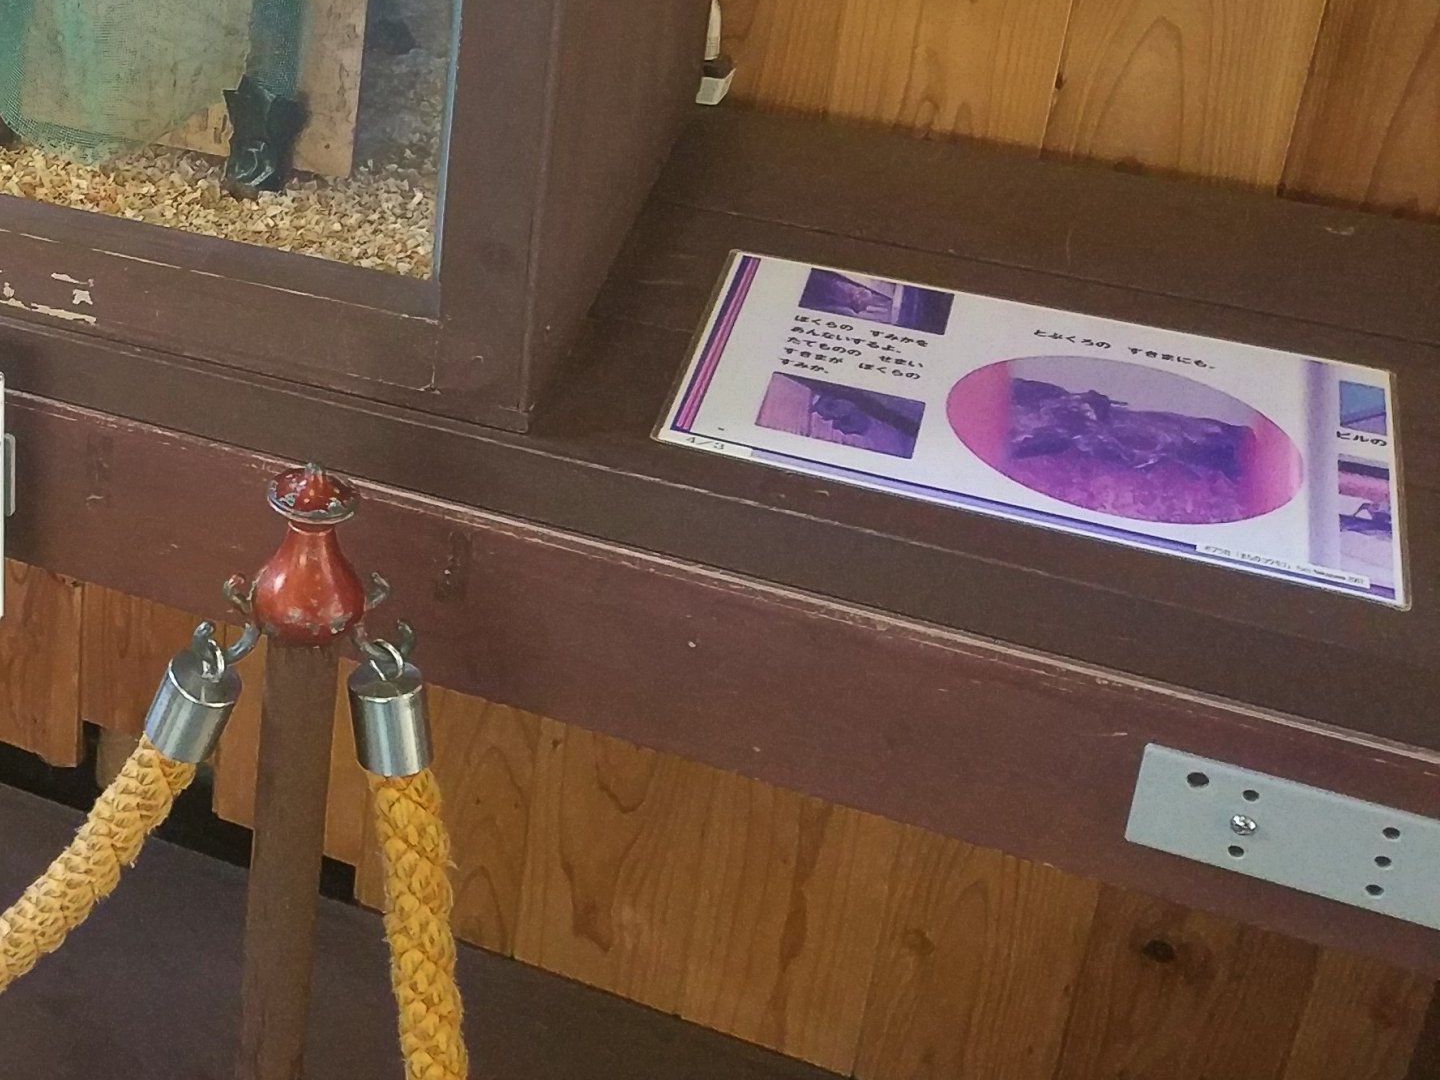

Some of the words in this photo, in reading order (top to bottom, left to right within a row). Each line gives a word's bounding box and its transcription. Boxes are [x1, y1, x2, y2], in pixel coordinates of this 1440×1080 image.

[783, 346, 844, 364] すきまが
[786, 336, 862, 357] たてものの
[878, 355, 924, 369] せまい
[1336, 430, 1388, 447] ビルの
